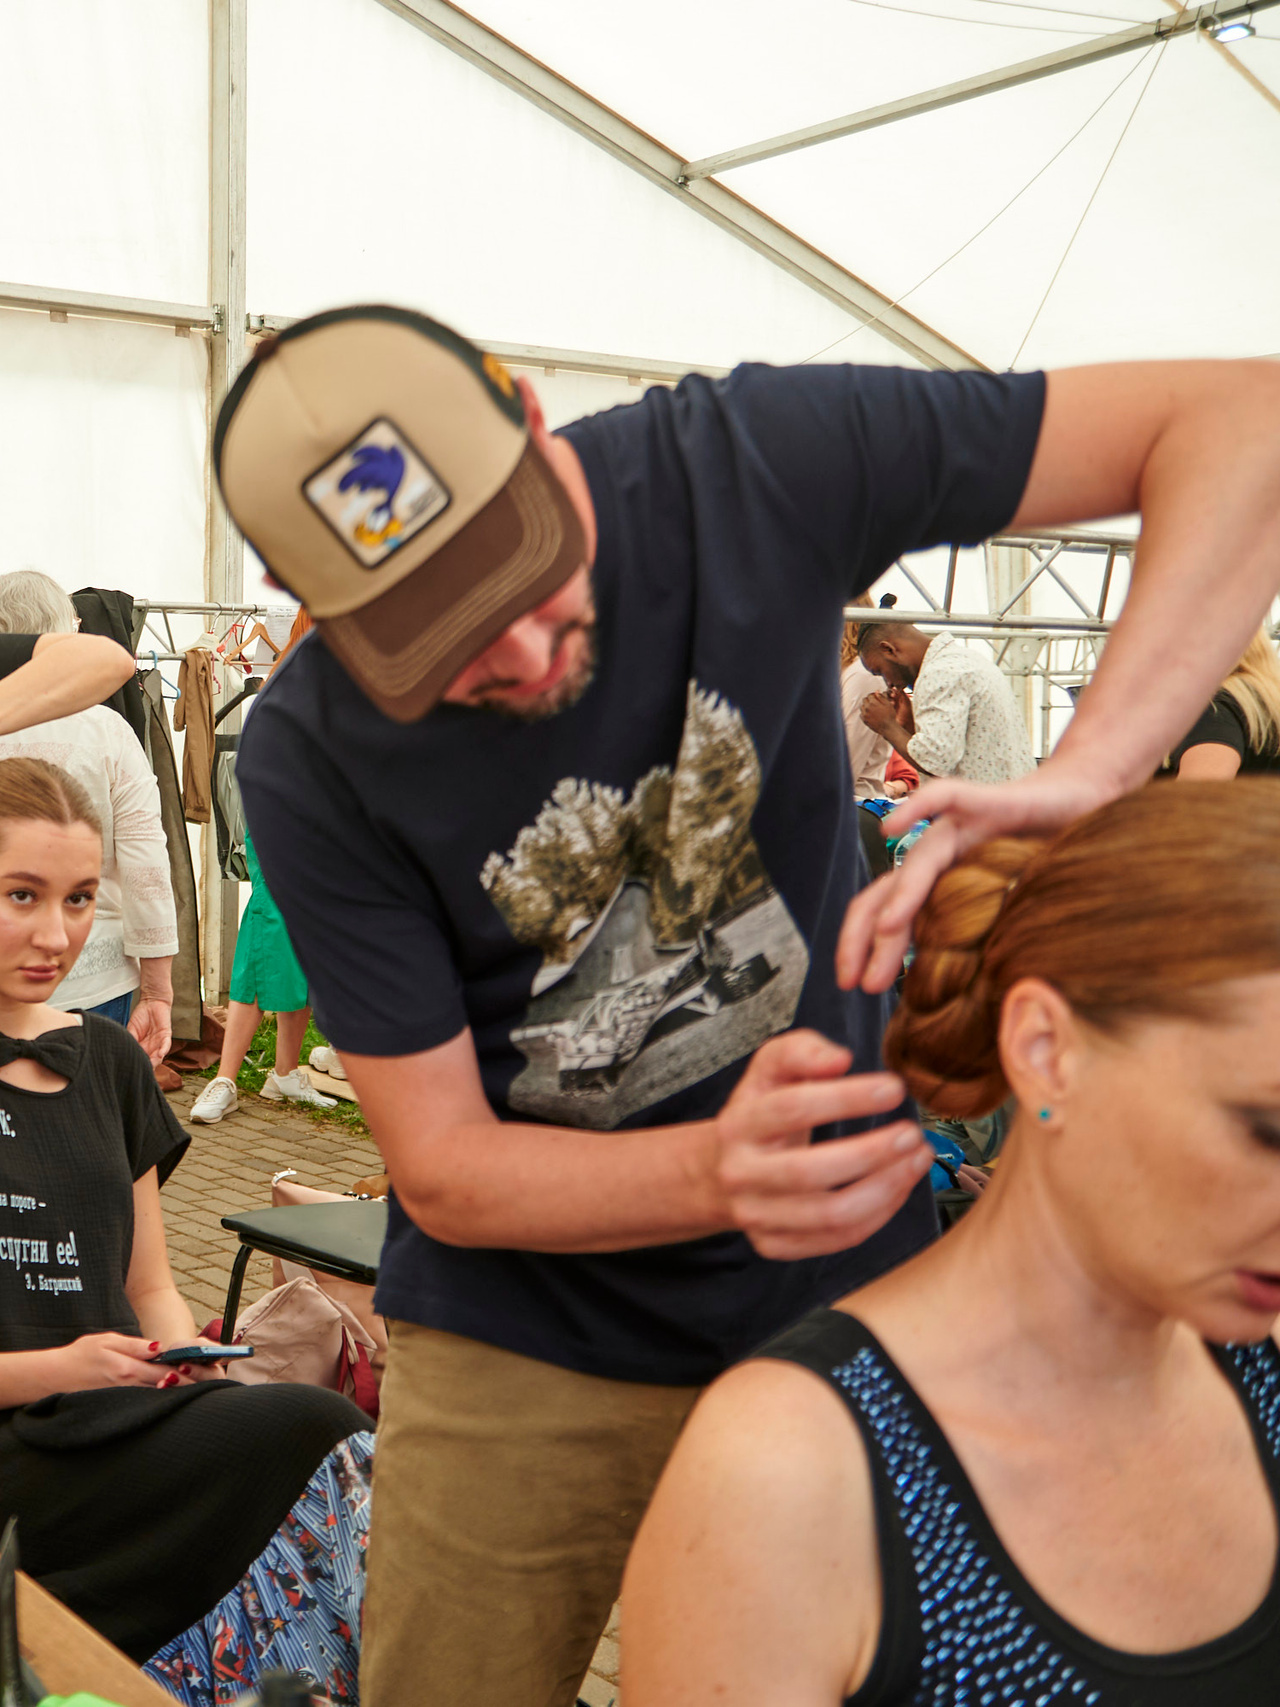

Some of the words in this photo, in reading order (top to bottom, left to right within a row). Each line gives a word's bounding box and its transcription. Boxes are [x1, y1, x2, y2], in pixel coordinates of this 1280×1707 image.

[55, 1230, 80, 1267] ее!
[25, 1272, 36, 1291] Э.
[38, 1273, 84, 1297] Багрицкий
